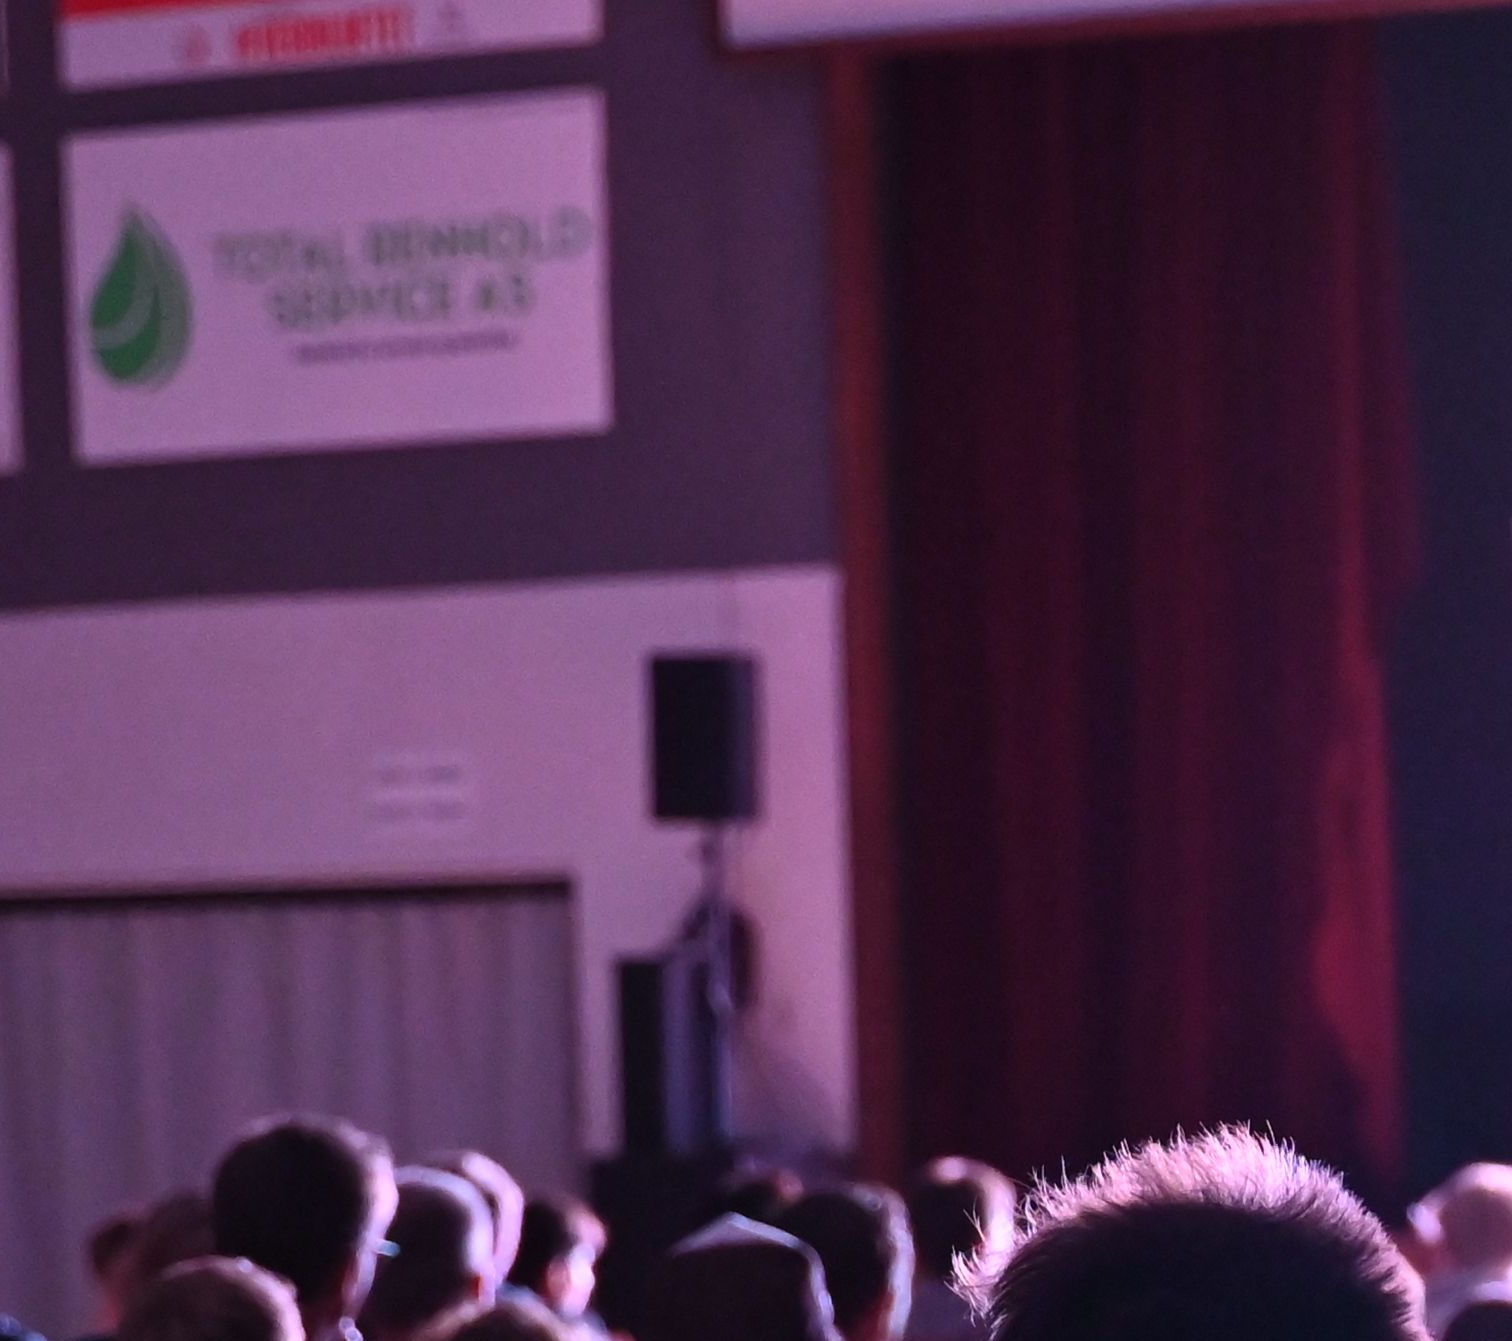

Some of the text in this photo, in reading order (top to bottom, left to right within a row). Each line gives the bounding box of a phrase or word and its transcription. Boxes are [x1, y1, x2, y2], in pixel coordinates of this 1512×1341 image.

[212, 206, 594, 284] TOTAL RENHOLD
[268, 274, 452, 332] SERVICE
